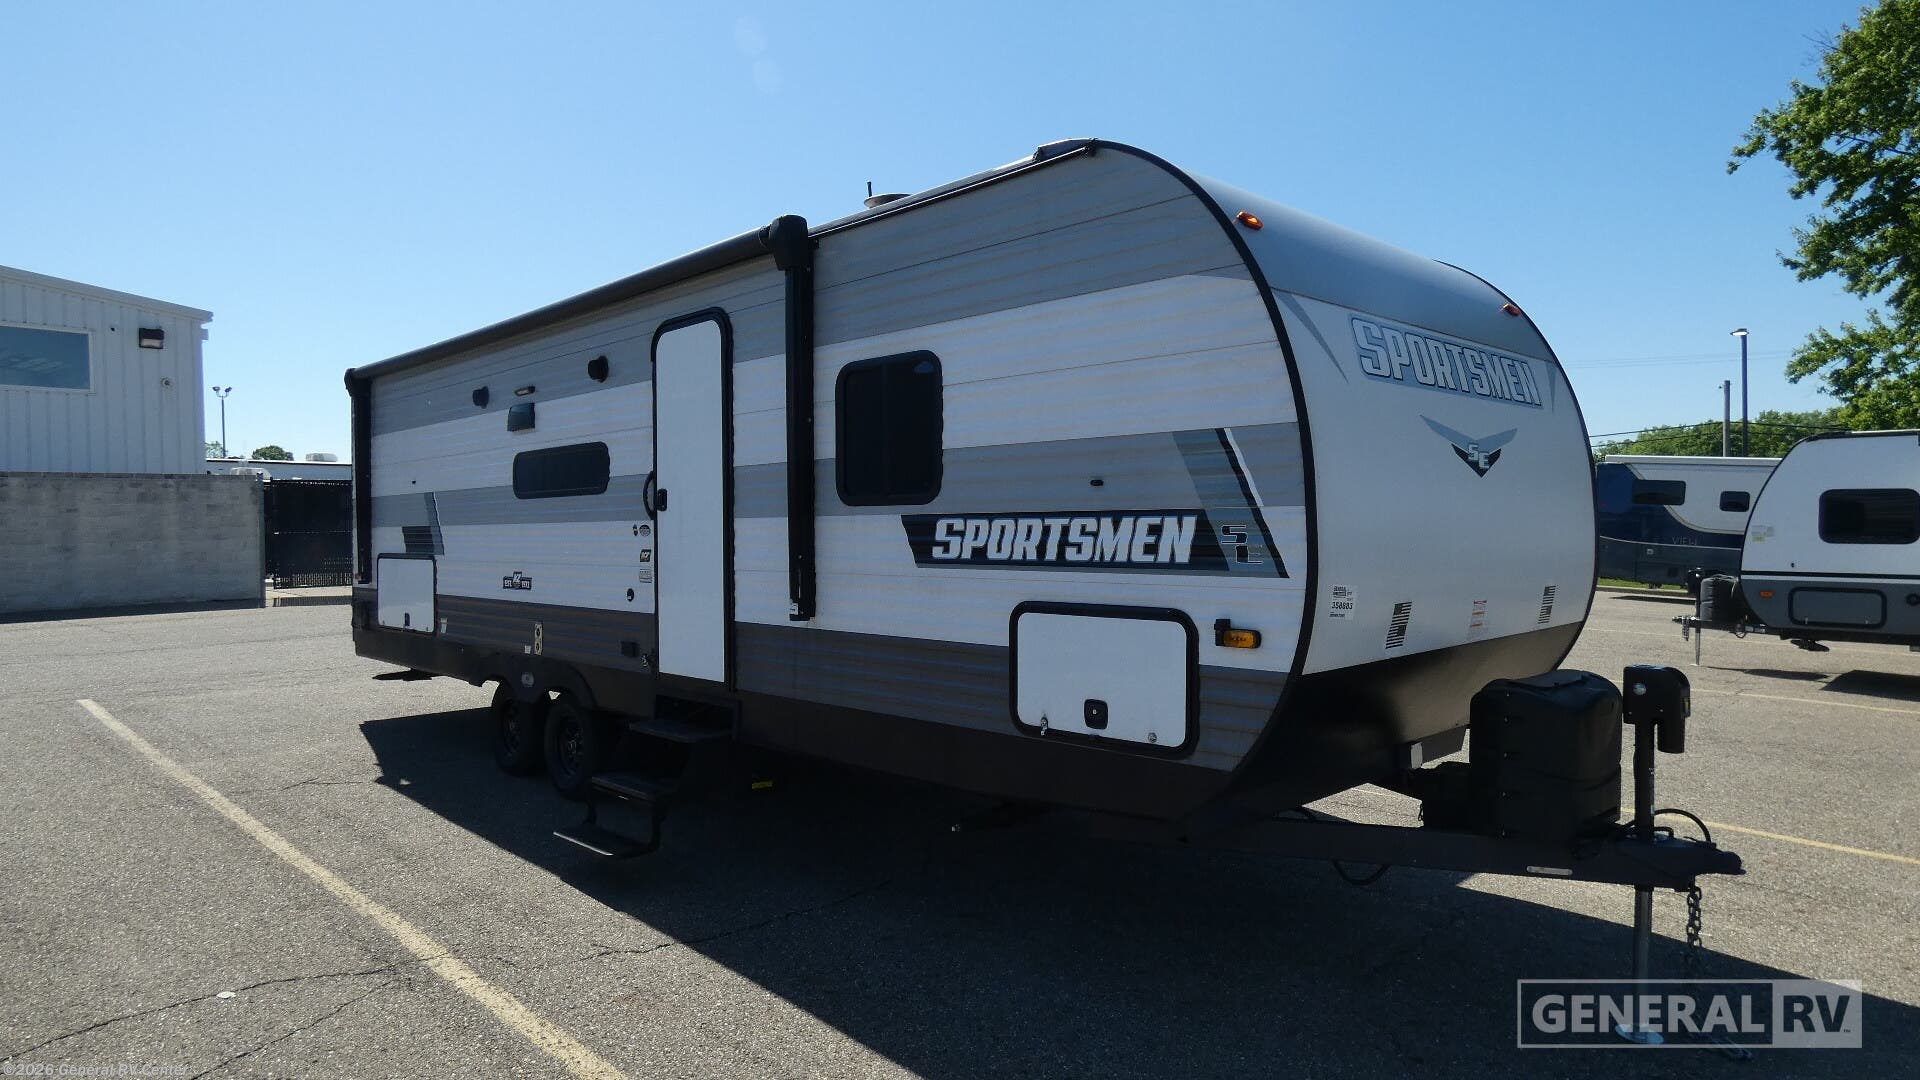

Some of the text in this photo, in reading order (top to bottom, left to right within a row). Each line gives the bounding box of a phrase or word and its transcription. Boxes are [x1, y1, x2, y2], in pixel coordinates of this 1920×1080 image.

[1352, 318, 1542, 406] SPORTSMEN
[1468, 443, 1490, 469] SE
[931, 515, 1198, 564] SPORTSMEN
